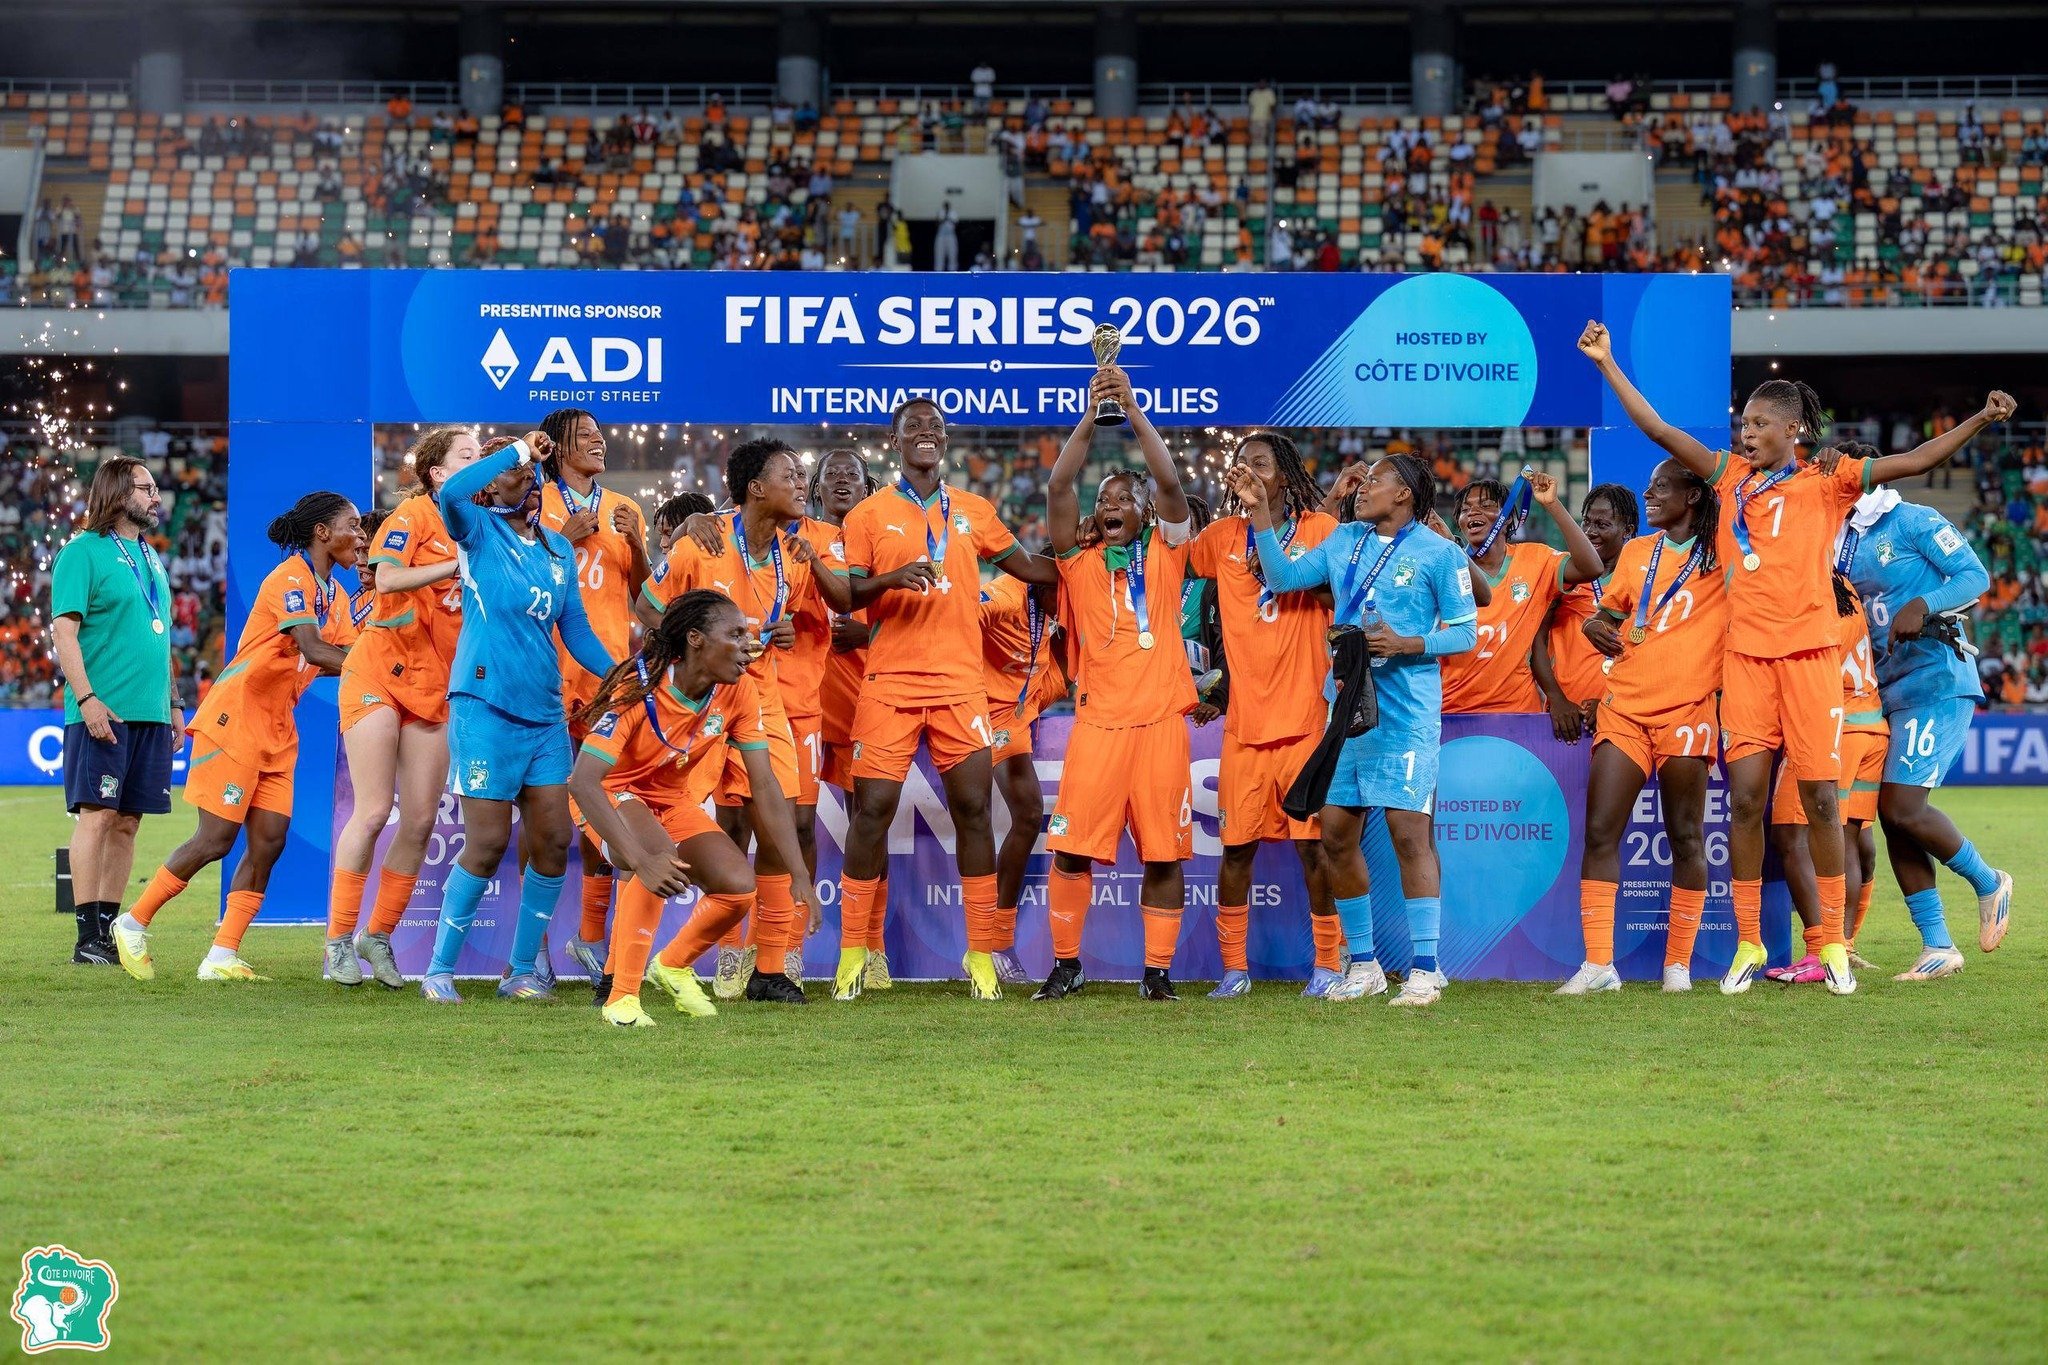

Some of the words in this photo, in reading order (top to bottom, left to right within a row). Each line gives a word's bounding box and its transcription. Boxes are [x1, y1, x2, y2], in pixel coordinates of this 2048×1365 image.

[480, 304, 582, 319] PRESENTING
[584, 304, 662, 319] SPONSOR
[726, 296, 864, 344] FIFA
[878, 295, 1094, 346] SERIES
[1396, 332, 1463, 346] HOSTED
[1466, 332, 1488, 346] BY
[529, 337, 663, 382] ADI
[1354, 358, 1417, 382] CÔTE
[1424, 363, 1519, 382] D'IVOIRE
[529, 390, 596, 402] PREDICT
[601, 390, 661, 402] STREET
[1039, 388, 1219, 414] FRIDLIES
[1768, 496, 1786, 537] 7
[1382, 543, 1394, 558] FIFA
[1476, 545, 1487, 557] FIFA
[1482, 528, 1499, 547] SERIES
[1840, 548, 1848, 561] FIFA
[576, 547, 604, 590] 26
[1350, 550, 1361, 564] FIFA
[1370, 555, 1386, 576] SERIES
[1677, 569, 1688, 583] FIFA
[1685, 549, 1701, 572] SERIES
[1184, 581, 1195, 595] 2026
[1361, 575, 1374, 590] 2026
[526, 586, 553, 621] 23
[1477, 620, 1508, 659] 21
[1829, 707, 1844, 750] 7
[1904, 717, 1936, 757] 16
[1400, 750, 1416, 781] 1
[1179, 787, 1193, 828] 6
[1438, 800, 1499, 813] HOSTED
[1502, 800, 1522, 812] BY
[1464, 823, 1553, 841] D'IVOIRE
[1626, 831, 1730, 866] 206
